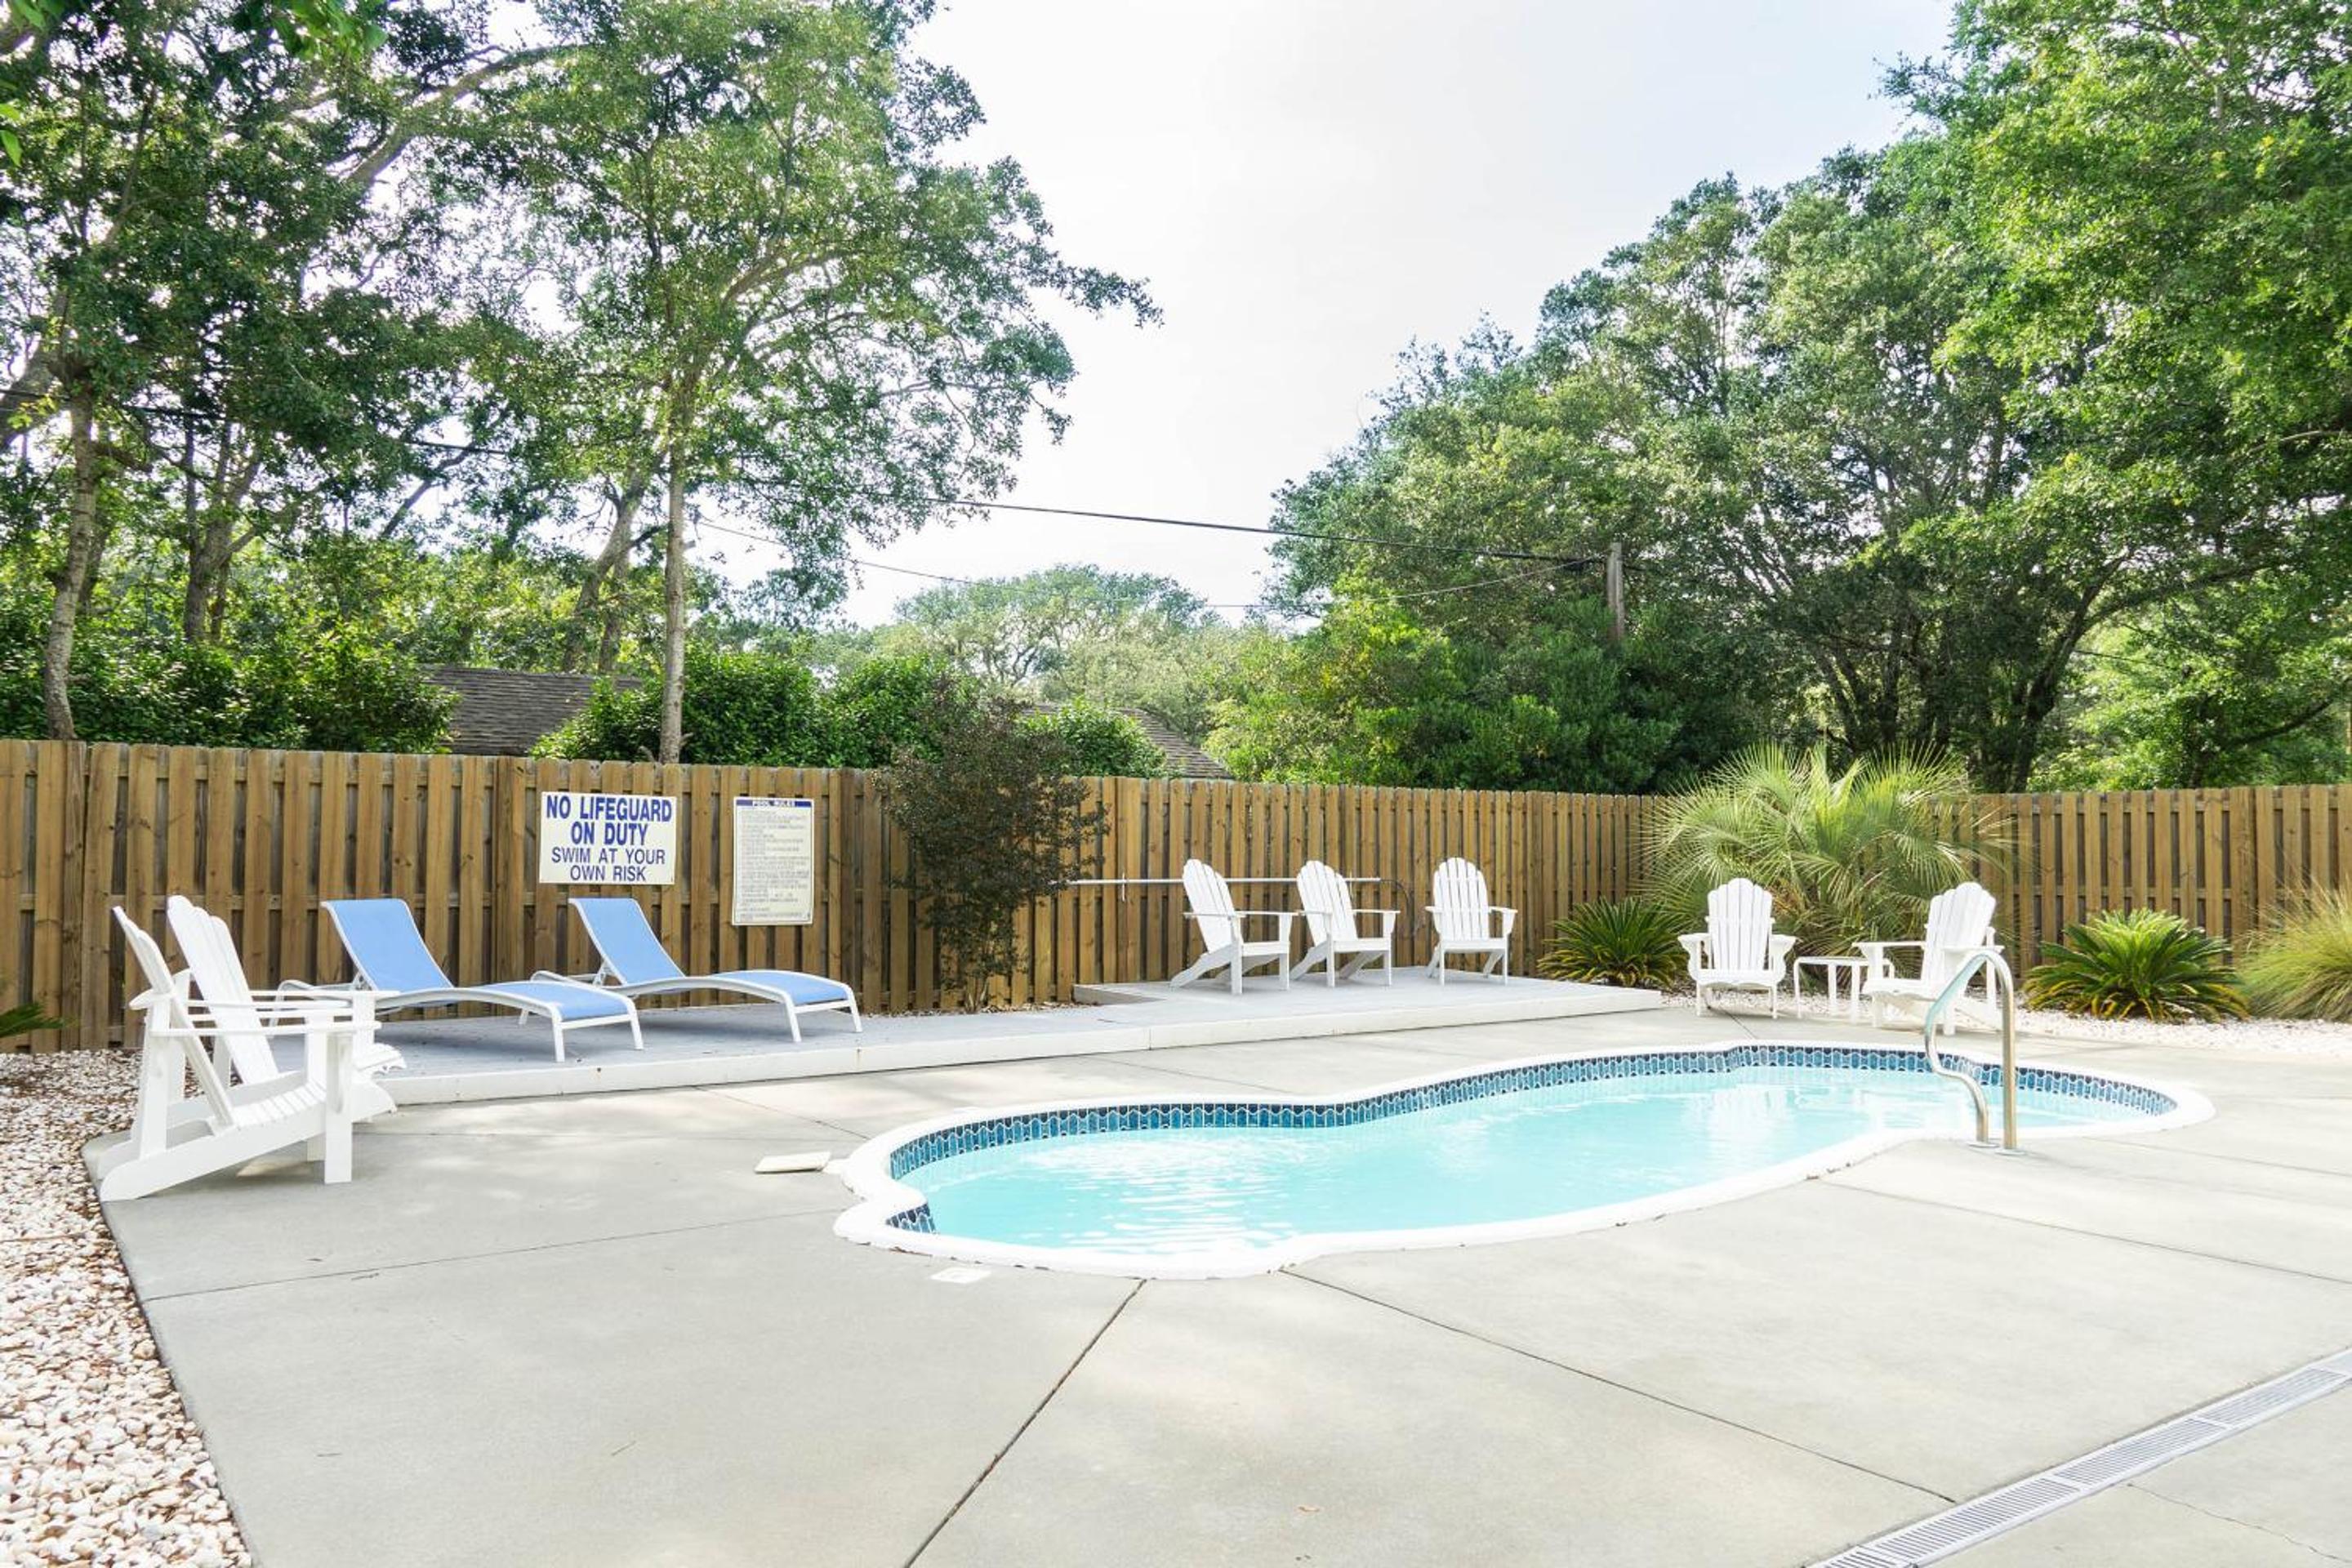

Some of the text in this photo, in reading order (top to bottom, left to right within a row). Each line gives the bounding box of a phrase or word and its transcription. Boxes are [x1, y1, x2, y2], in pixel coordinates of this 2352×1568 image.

[546, 795, 672, 822] NO LIFEGUARD
[572, 821, 648, 845] ON DUTY
[551, 847, 666, 865] SWIM AT YOUR
[570, 865, 647, 881] OWN RISK
